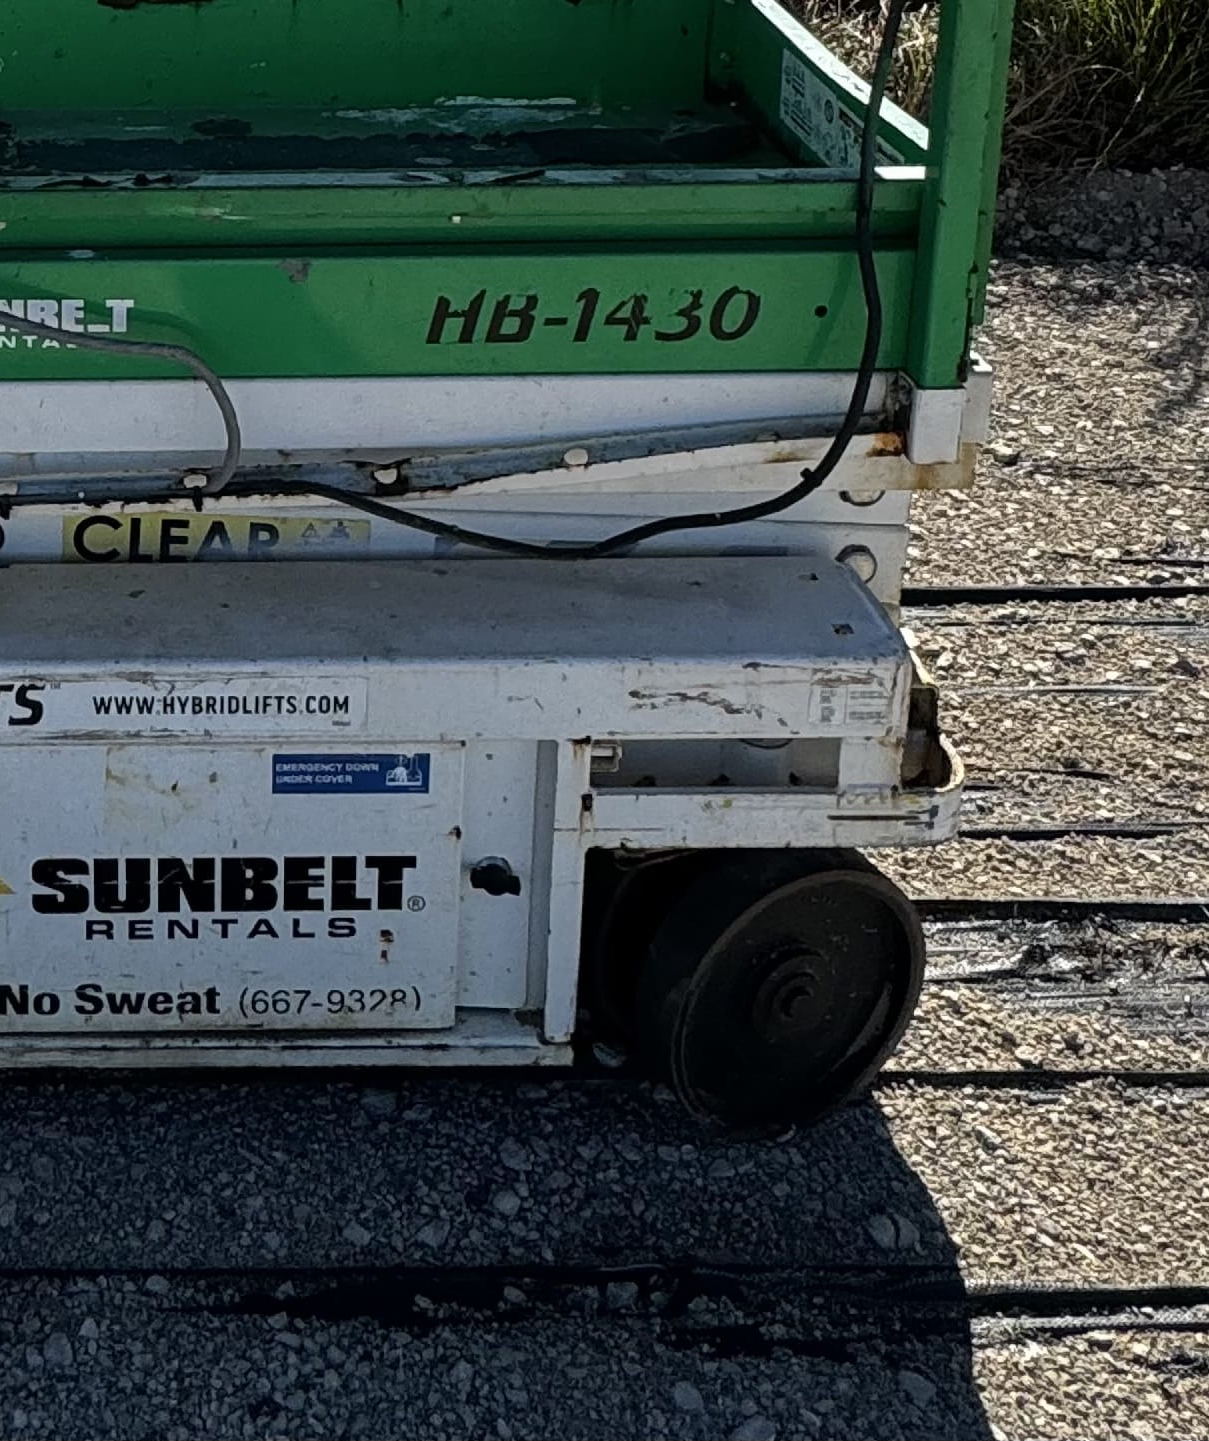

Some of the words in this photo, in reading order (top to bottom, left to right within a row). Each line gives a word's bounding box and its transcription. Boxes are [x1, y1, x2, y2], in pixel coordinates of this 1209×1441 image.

[425, 285, 762, 345] HB-1430
[73, 515, 280, 562] CLEAR
[92, 695, 349, 715] WWW.HYBRIDLIFTS.COM
[275, 763, 343, 772] EMERGENCY
[345, 763, 379, 772] DOWN
[275, 775, 312, 784] UNDER
[315, 775, 353, 784] COVER
[31, 855, 417, 914] SUNBELT
[85, 917, 357, 941] RENTALS
[74, 983, 221, 1016] Sweat
[239, 986, 421, 1018] (667-9328)
